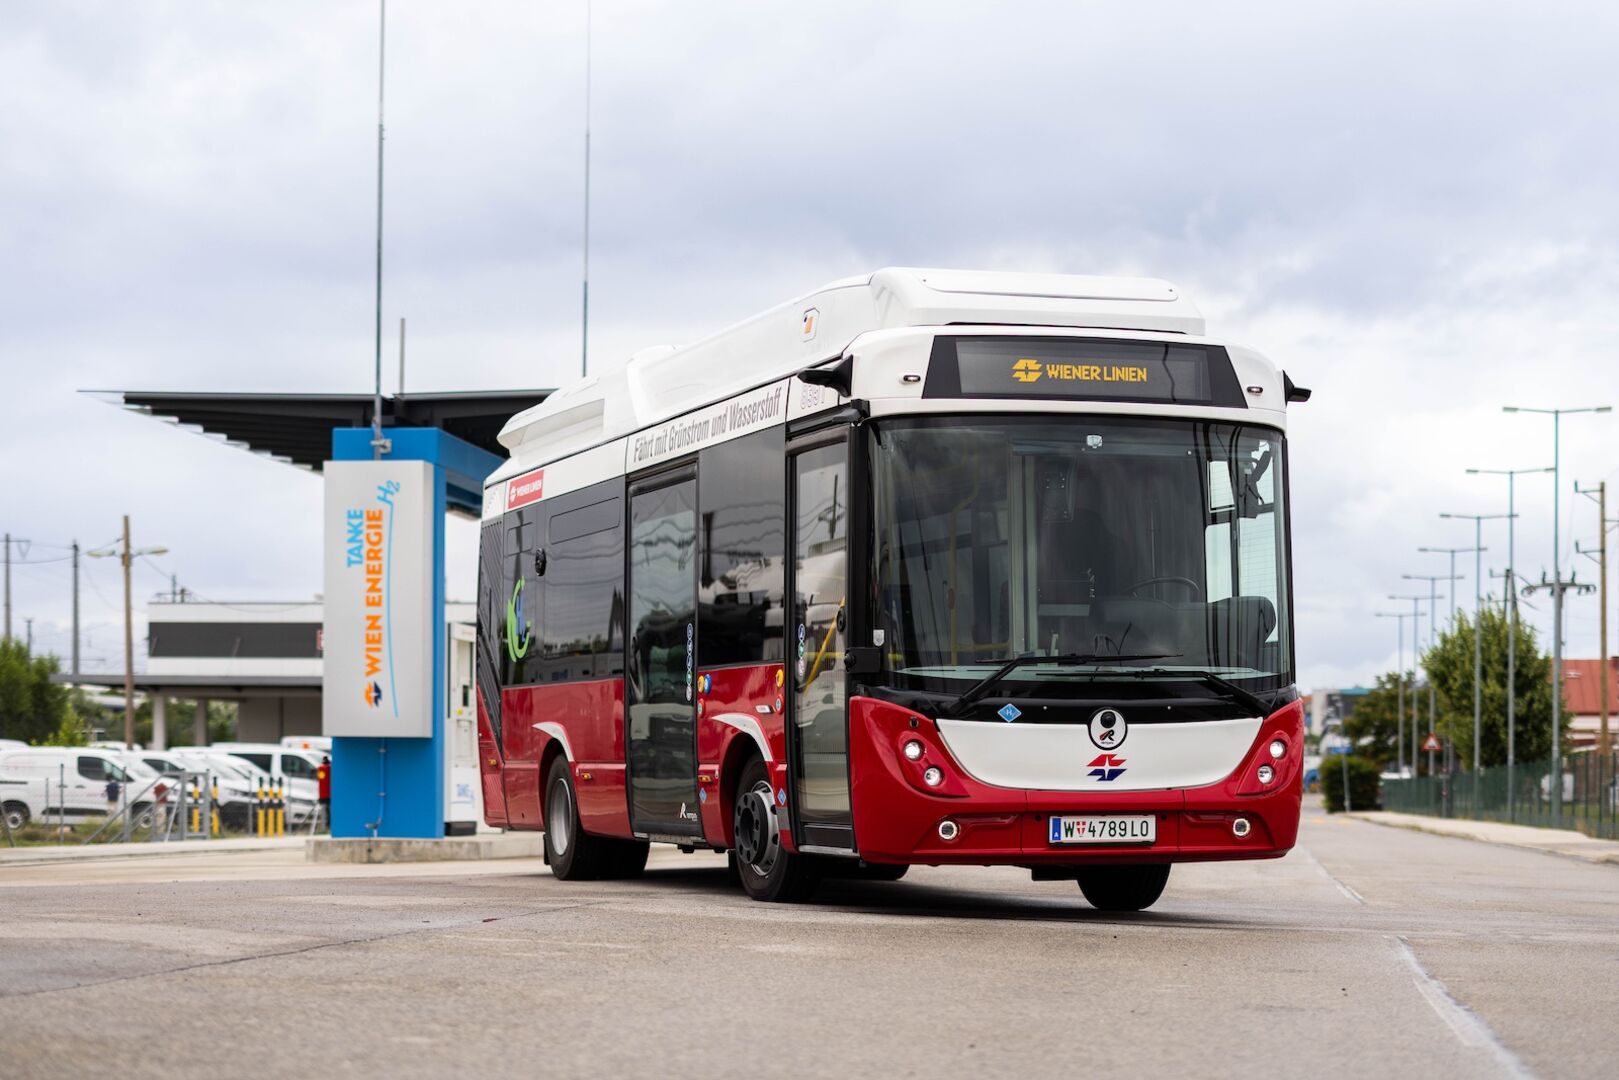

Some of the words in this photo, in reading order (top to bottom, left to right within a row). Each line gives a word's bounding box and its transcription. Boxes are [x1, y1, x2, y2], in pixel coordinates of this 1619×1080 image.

[1046, 364, 1101, 380] WIENER
[1103, 366, 1147, 382] LINIEN
[633, 433, 654, 463] Fährt
[654, 428, 668, 455] mit
[668, 418, 710, 451] Grünstrom
[711, 406, 729, 437] und
[729, 387, 783, 431] Wasserstoff
[376, 479, 401, 507] H2
[347, 509, 364, 568] TANKE
[365, 508, 384, 608] ENERGIE
[365, 614, 383, 678] WIEN
